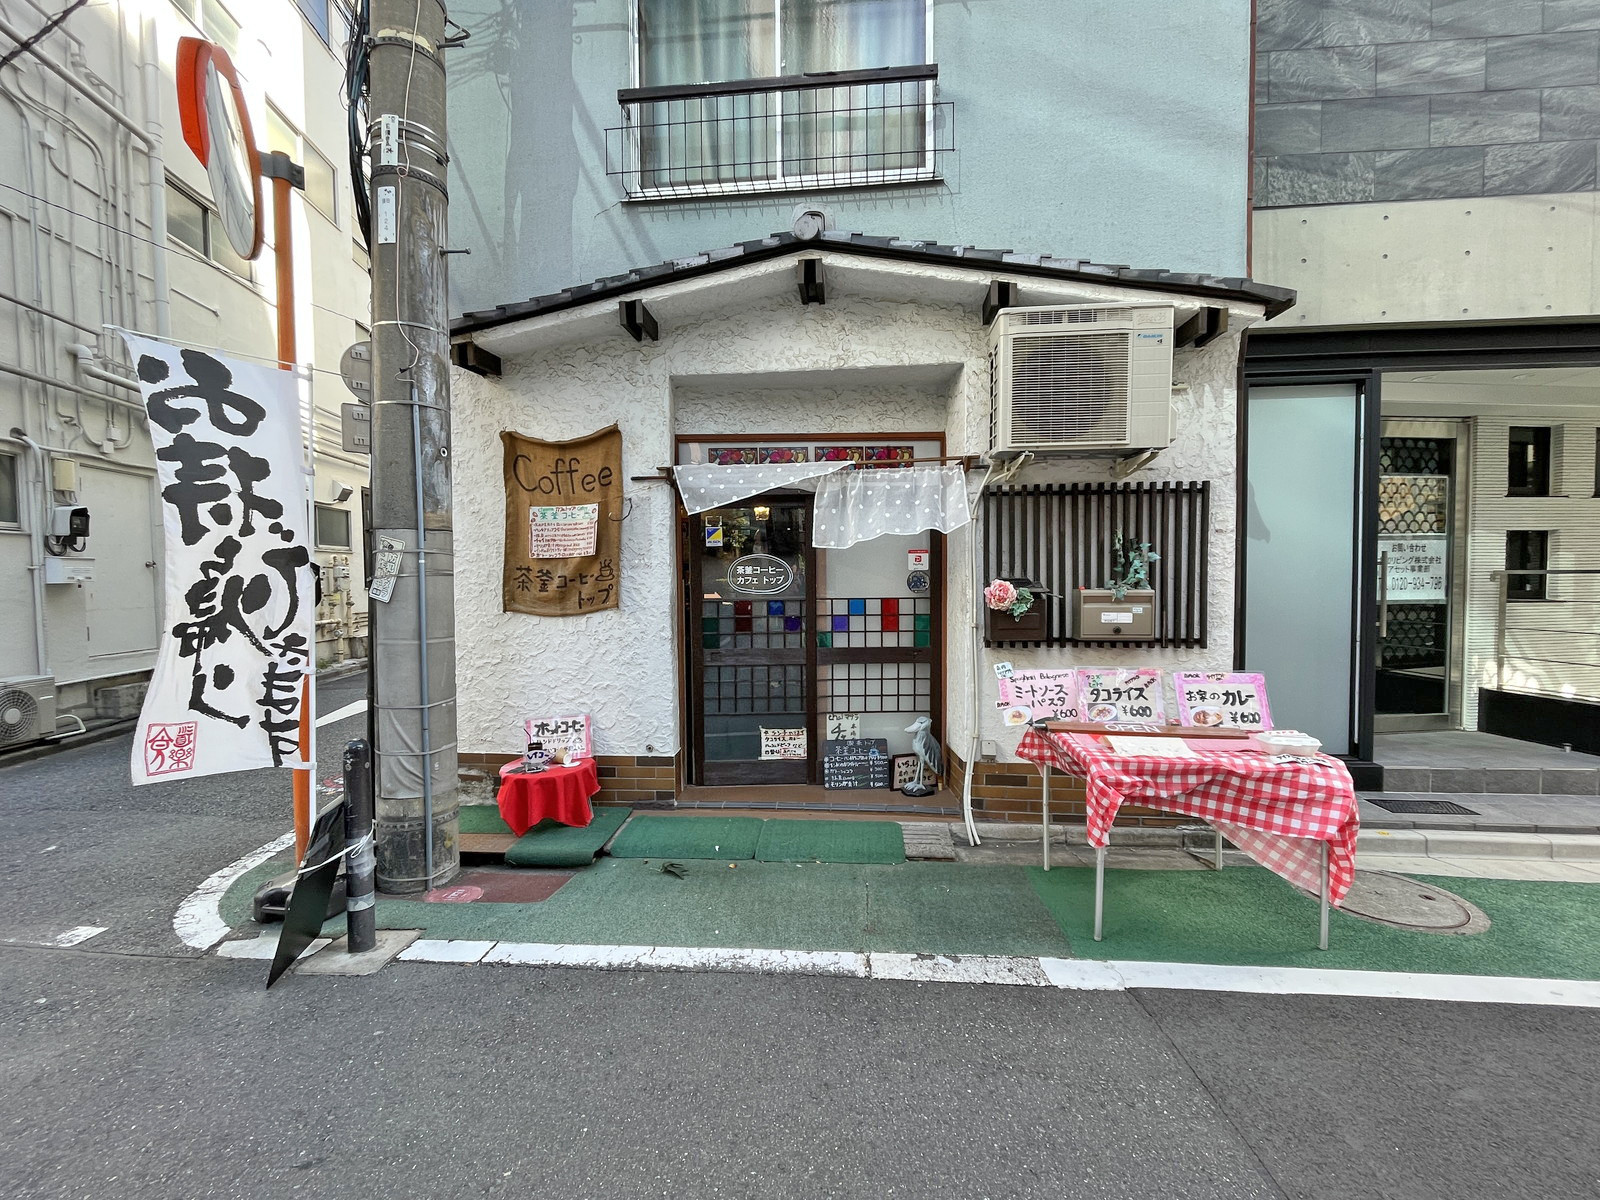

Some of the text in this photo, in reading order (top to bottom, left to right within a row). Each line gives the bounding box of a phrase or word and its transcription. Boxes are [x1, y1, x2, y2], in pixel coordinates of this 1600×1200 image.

[513, 454, 613, 495] Coffee
[1391, 543, 1427, 553] お問い合わせ
[736, 566, 784, 575] 茶釜コーヒー
[513, 564, 596, 592] 茶釜コーヒー
[577, 584, 614, 609] トップ
[1015, 684, 1069, 699] ミートソース
[1090, 687, 1149, 703] タコライス
[1031, 696, 1066, 708] パスタ
[1052, 709, 1078, 720] ¥600
[1121, 705, 1153, 718] ¥600
[1229, 711, 1262, 724] ¥600
[1104, 724, 1162, 733] OPEN
